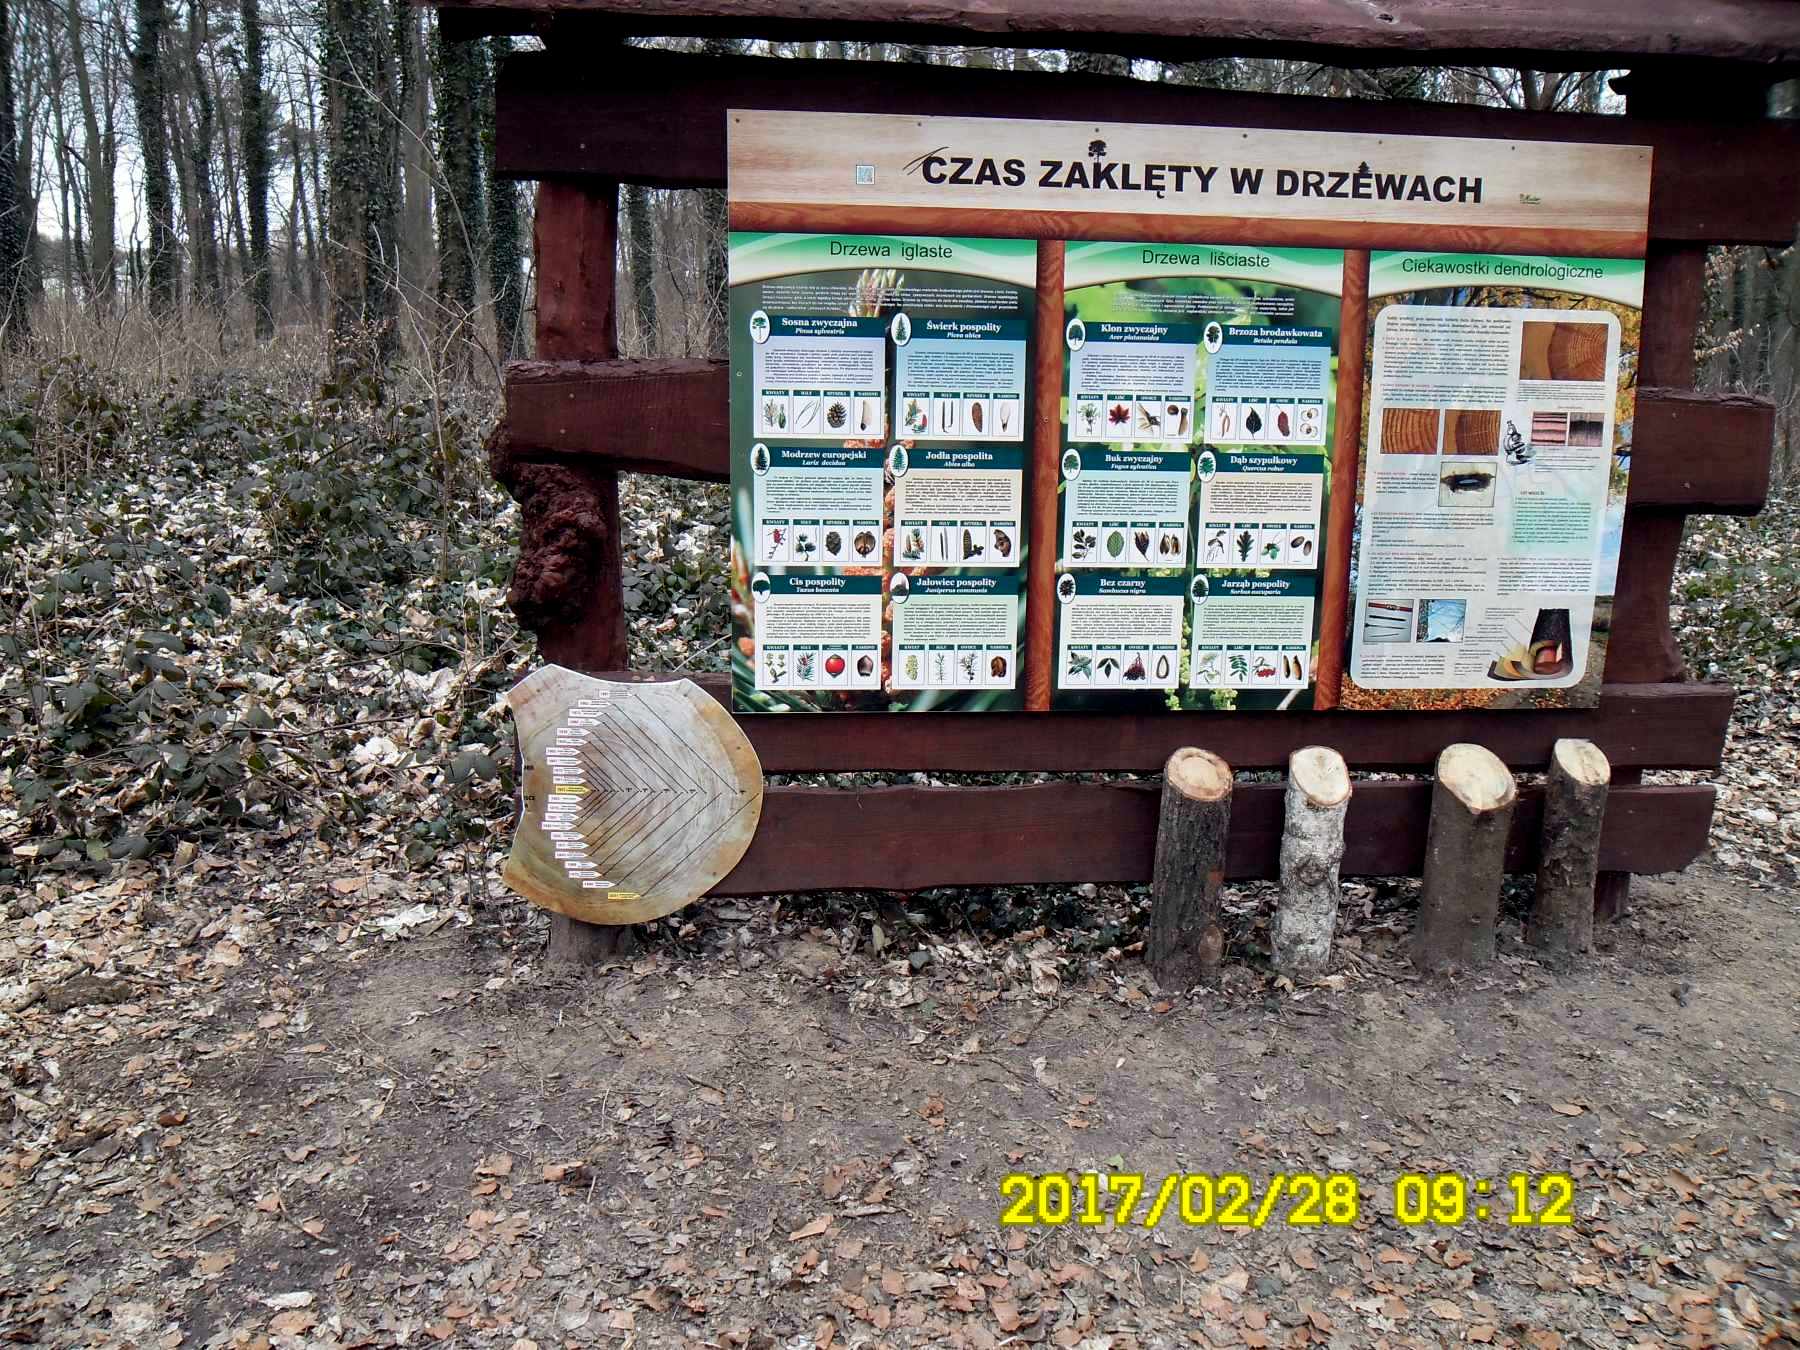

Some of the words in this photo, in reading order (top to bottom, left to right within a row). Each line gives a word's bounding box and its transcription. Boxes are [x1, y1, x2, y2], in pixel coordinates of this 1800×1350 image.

[922, 156, 1026, 186] CZAS
[1038, 160, 1218, 199] ZAKLĘTY
[1230, 167, 1264, 194] W
[1276, 168, 1482, 203] DRZEWACH
[830, 241, 891, 258] Drzewa
[901, 242, 953, 261] iglaste
[1143, 250, 1200, 266] Drzewa
[1209, 251, 1270, 268] liściaste
[1402, 258, 1490, 275] Ciekawostki
[1493, 261, 1603, 281] dendrologiczne
[782, 318, 809, 327] Sosna
[811, 318, 858, 328] zwyczajna
[926, 320, 958, 331] Świerk
[960, 321, 1002, 333] pospolity
[1101, 324, 1123, 333] Klon
[1124, 325, 1168, 335] zwyczajny
[1229, 327, 1259, 336] Brzoza
[1260, 328, 1323, 337] brodawkowata
[781, 450, 820, 458] Modrzew
[821, 451, 867, 460] europejski
[925, 451, 950, 460] Jodła
[952, 452, 993, 461] pospolita
[1105, 454, 1121, 462] Buk
[1123, 455, 1164, 464] zwyczajny
[1230, 456, 1247, 465] Dąb
[1248, 456, 1298, 467] szypułkowy
[789, 577, 804, 586] Cis
[805, 578, 846, 588] pospolity
[916, 578, 954, 586] Jałowiec
[956, 578, 997, 588] pospolity
[1100, 578, 1116, 586] Bez
[1117, 579, 1146, 588] czarny
[1222, 580, 1250, 589] Jarząb
[1252, 580, 1291, 590] pospolity
